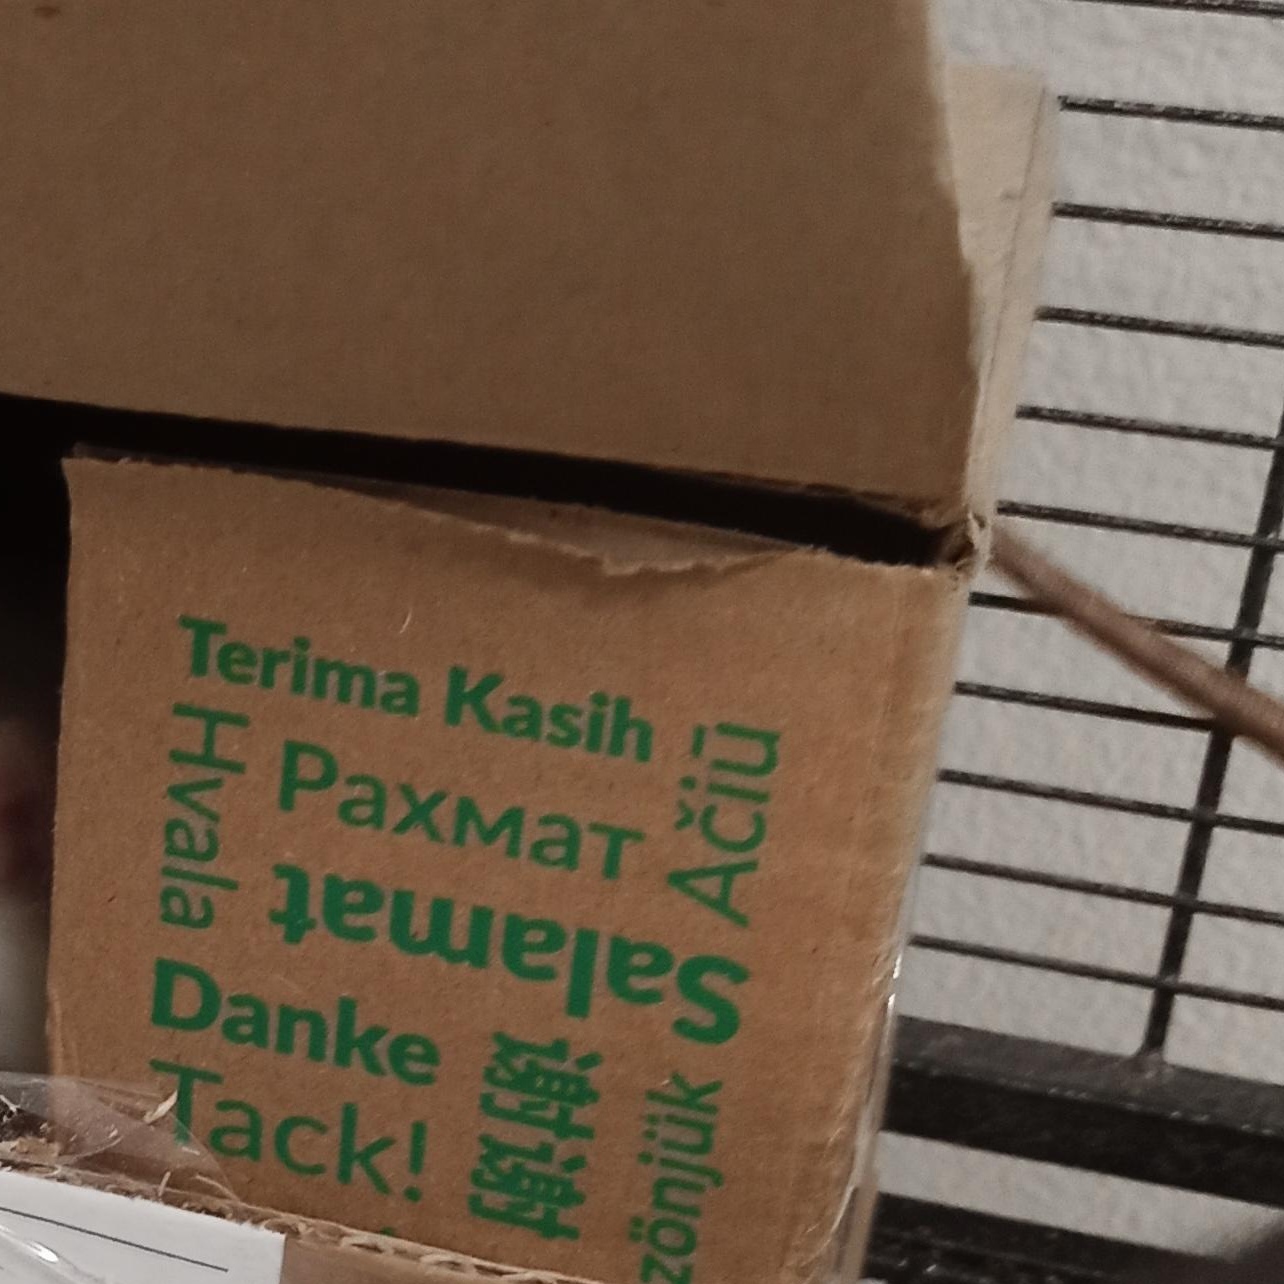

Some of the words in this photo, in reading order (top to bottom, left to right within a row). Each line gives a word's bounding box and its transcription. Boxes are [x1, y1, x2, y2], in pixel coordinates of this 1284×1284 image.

[178, 613, 422, 718] Terima
[444, 664, 656, 764] Kasih
[159, 702, 251, 931] Hvala
[667, 721, 783, 928] Ačiū
[149, 957, 443, 1088] Danke
[268, 863, 753, 1047] Salamat
[148, 1057, 429, 1204] Tack!
[467, 1031, 604, 1242] 謝謝
